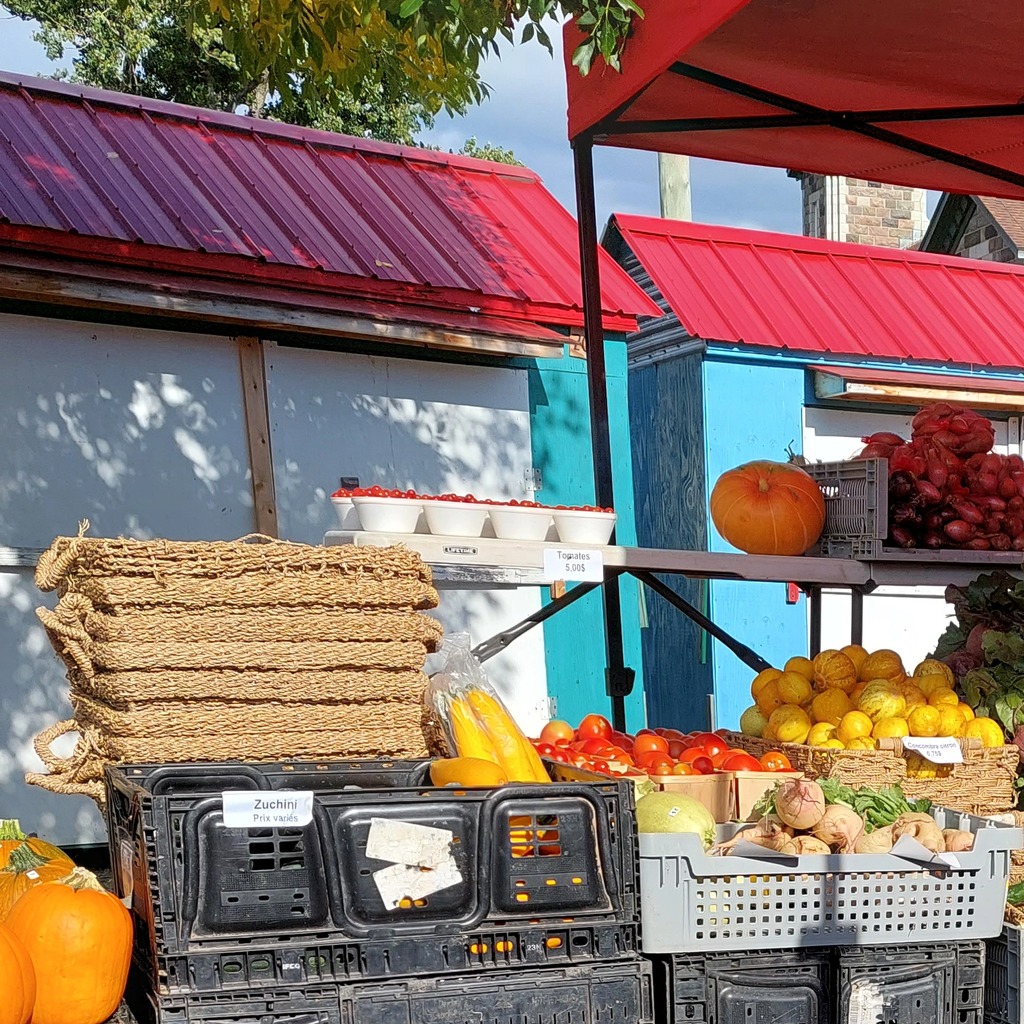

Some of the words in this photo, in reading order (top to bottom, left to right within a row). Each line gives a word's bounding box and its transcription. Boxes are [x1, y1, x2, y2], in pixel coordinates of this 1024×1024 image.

[557, 550, 590, 560] Tomates
[565, 563, 586, 572] 5,00$
[253, 799, 298, 810] Zuchini
[253, 813, 271, 823] Prix
[273, 812, 299, 823] variés
